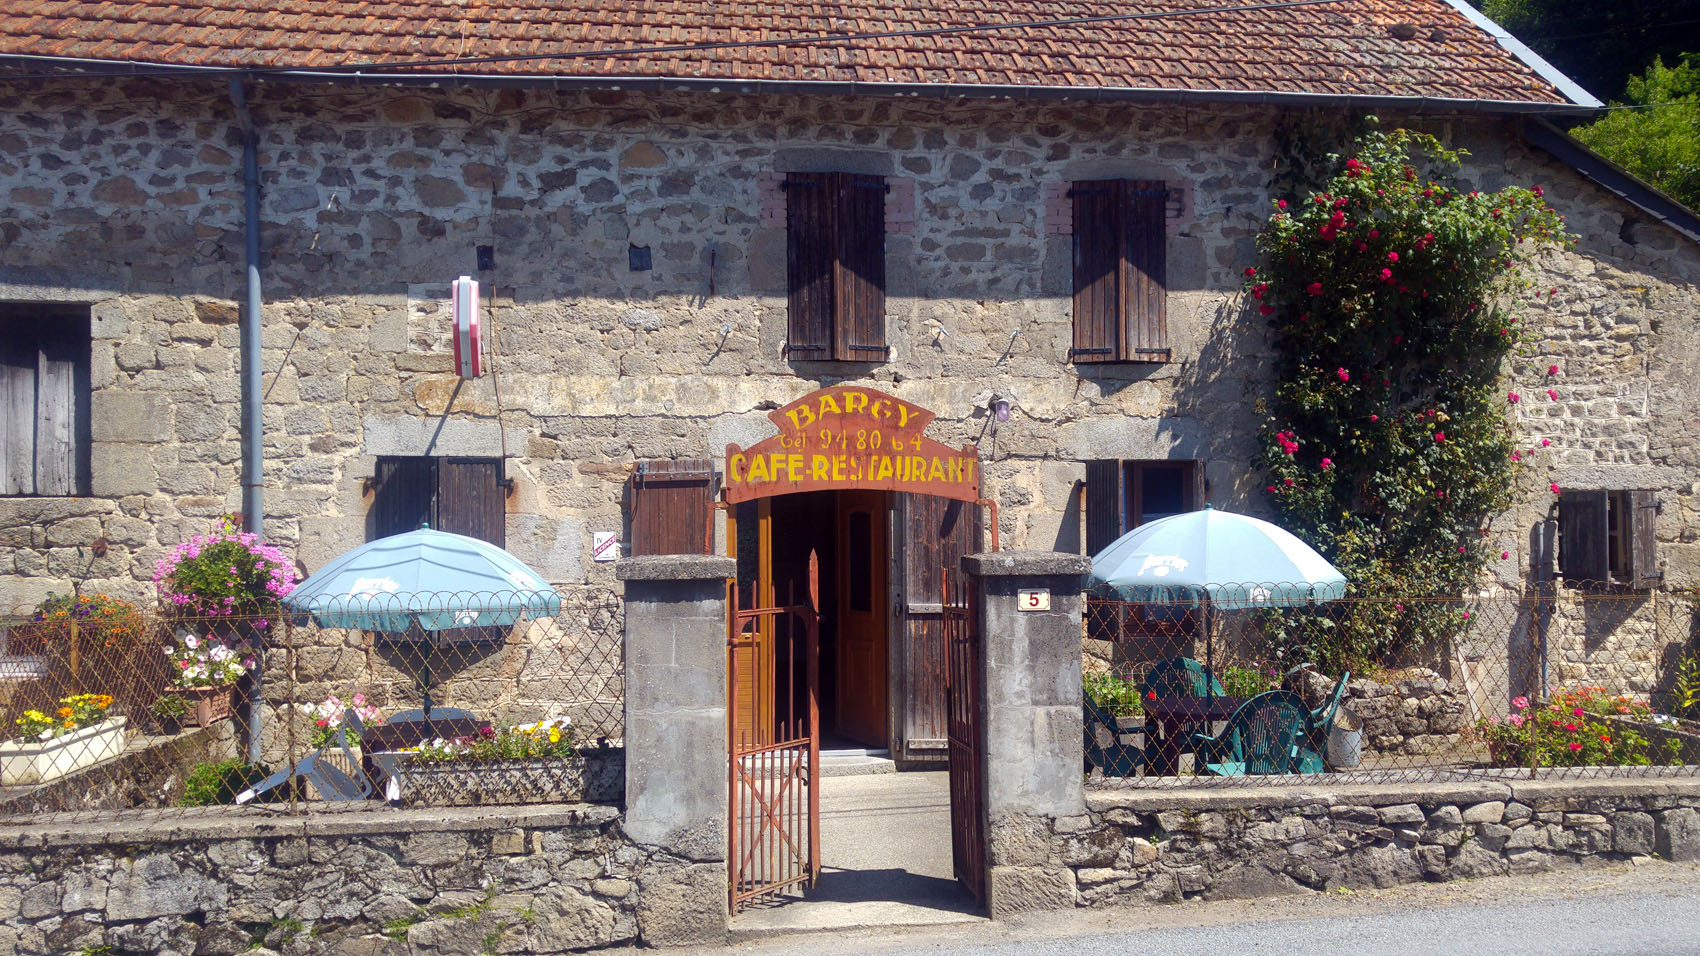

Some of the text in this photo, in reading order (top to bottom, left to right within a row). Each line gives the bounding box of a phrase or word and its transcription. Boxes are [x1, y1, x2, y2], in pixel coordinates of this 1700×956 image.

[785, 391, 920, 430] BARGY
[856, 429, 882, 449] 80
[1029, 592, 1039, 607] 5
